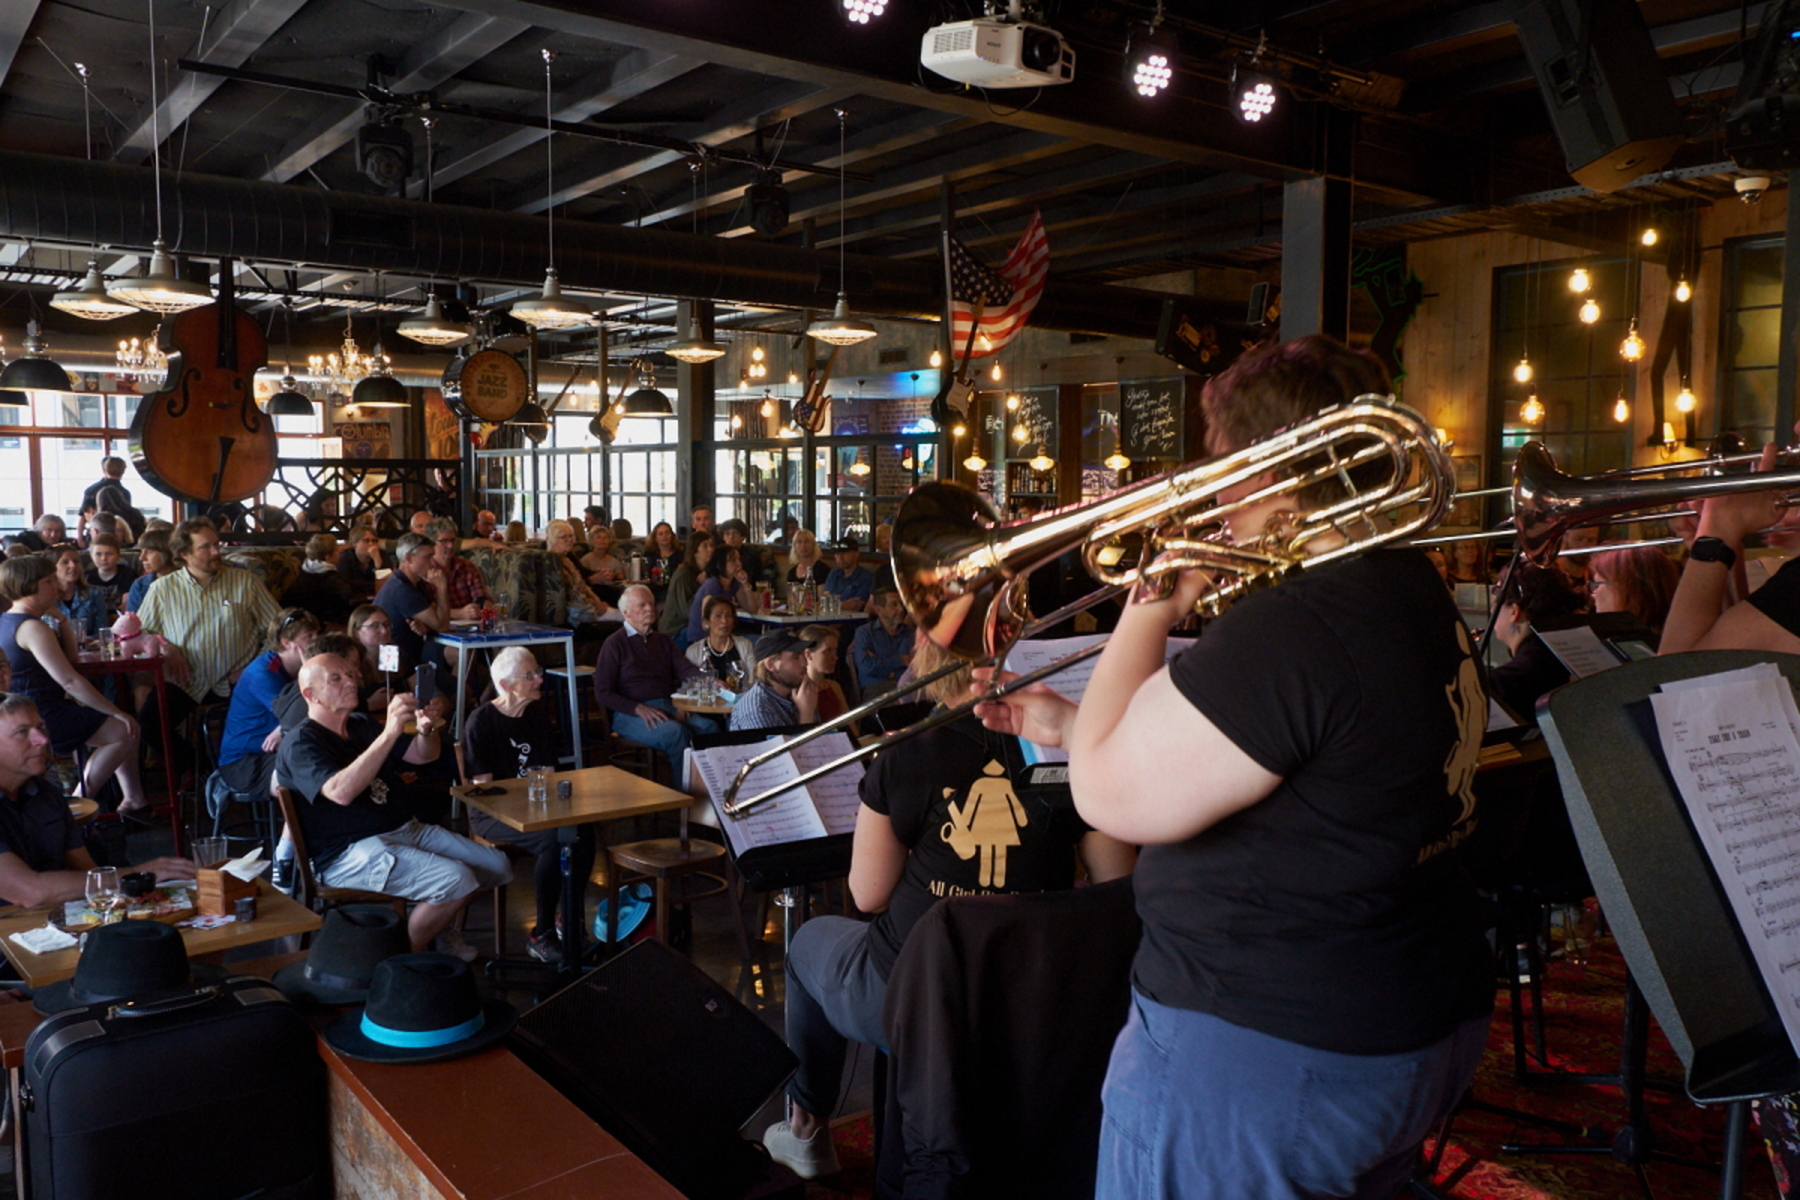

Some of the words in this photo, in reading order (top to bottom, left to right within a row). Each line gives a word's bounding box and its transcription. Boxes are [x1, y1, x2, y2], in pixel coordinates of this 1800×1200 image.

[477, 374, 508, 388] JAZZ
[477, 386, 508, 399] BAND
[926, 879, 945, 898] All
